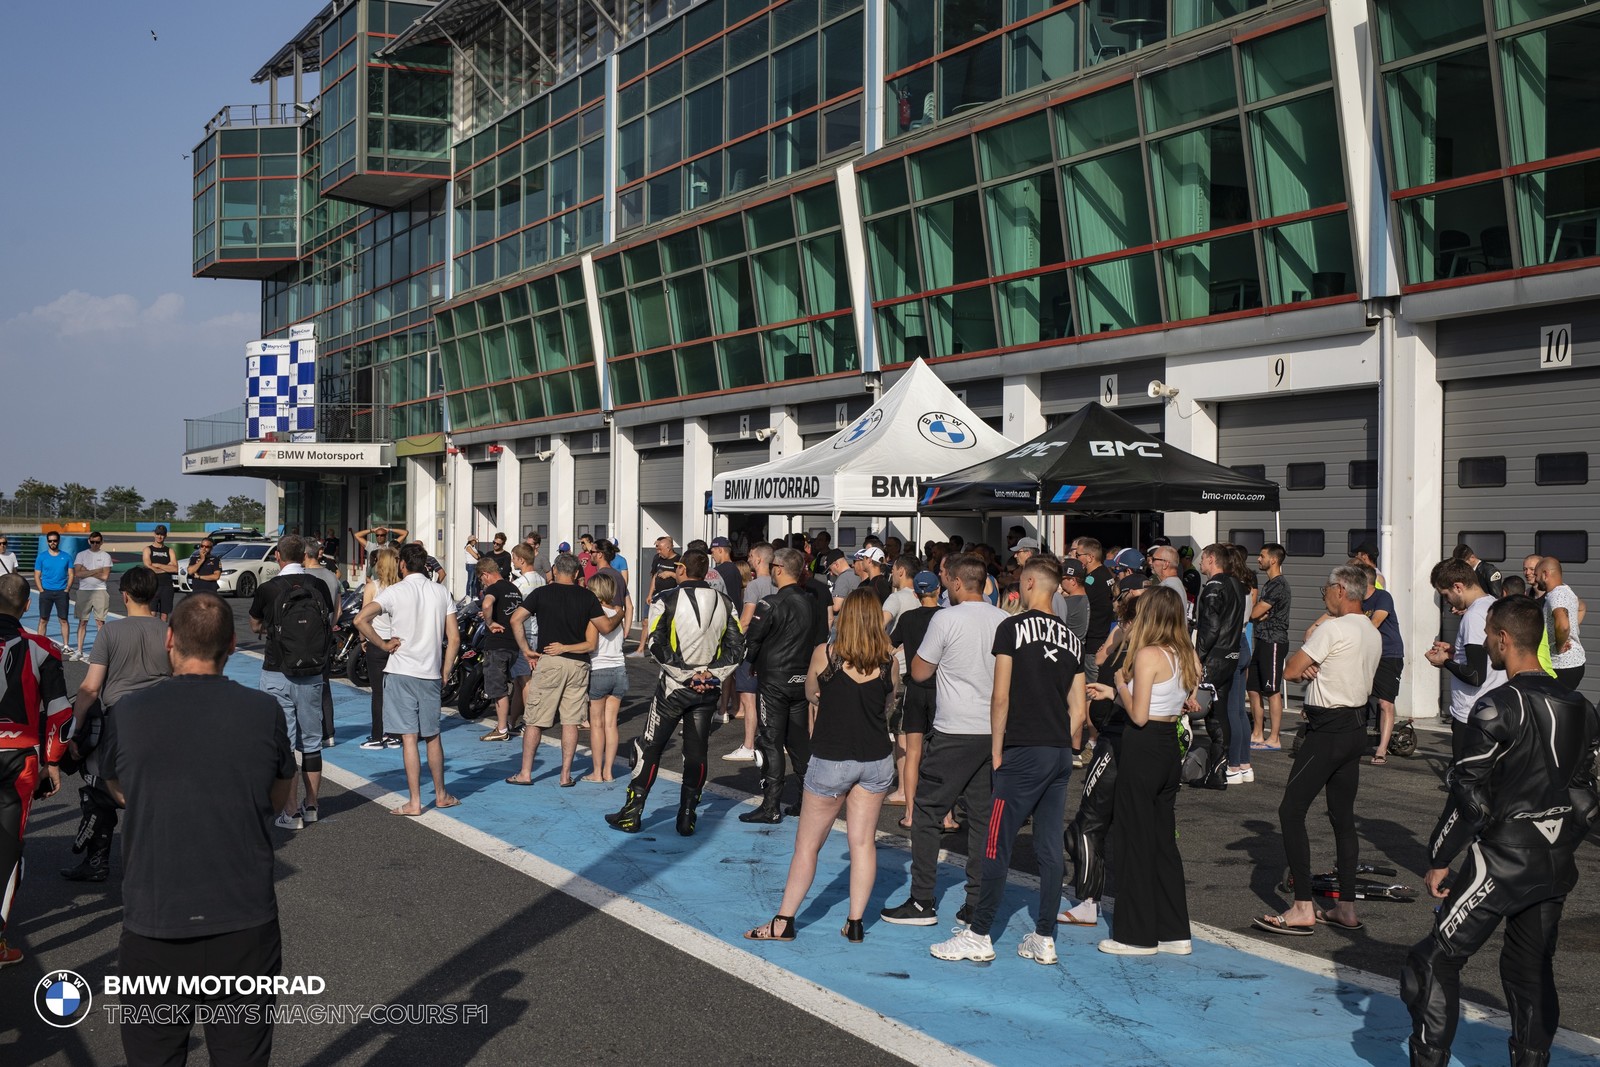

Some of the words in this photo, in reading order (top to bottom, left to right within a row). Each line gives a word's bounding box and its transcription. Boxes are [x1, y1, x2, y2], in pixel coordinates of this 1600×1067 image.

[1542, 328, 1569, 364] 10
[1274, 357, 1285, 388] 9
[1104, 377, 1113, 403] 8
[741, 417, 747, 436] 5
[838, 405, 845, 426] 6
[922, 413, 962, 427] BMW
[277, 450, 305, 460] BMW
[307, 450, 364, 462] Motorsport
[1089, 440, 1163, 457] BMC
[724, 479, 752, 499] BMW
[754, 476, 820, 499] MOTORRAD
[994, 489, 1030, 498] bmc-moto.com
[1201, 490, 1266, 501] bmc-moto.com
[1014, 616, 1082, 665] WICKED
[1086, 752, 1112, 798] DAINESE
[1432, 808, 1459, 860] DAINESE
[1443, 877, 1496, 939] DAINESE
